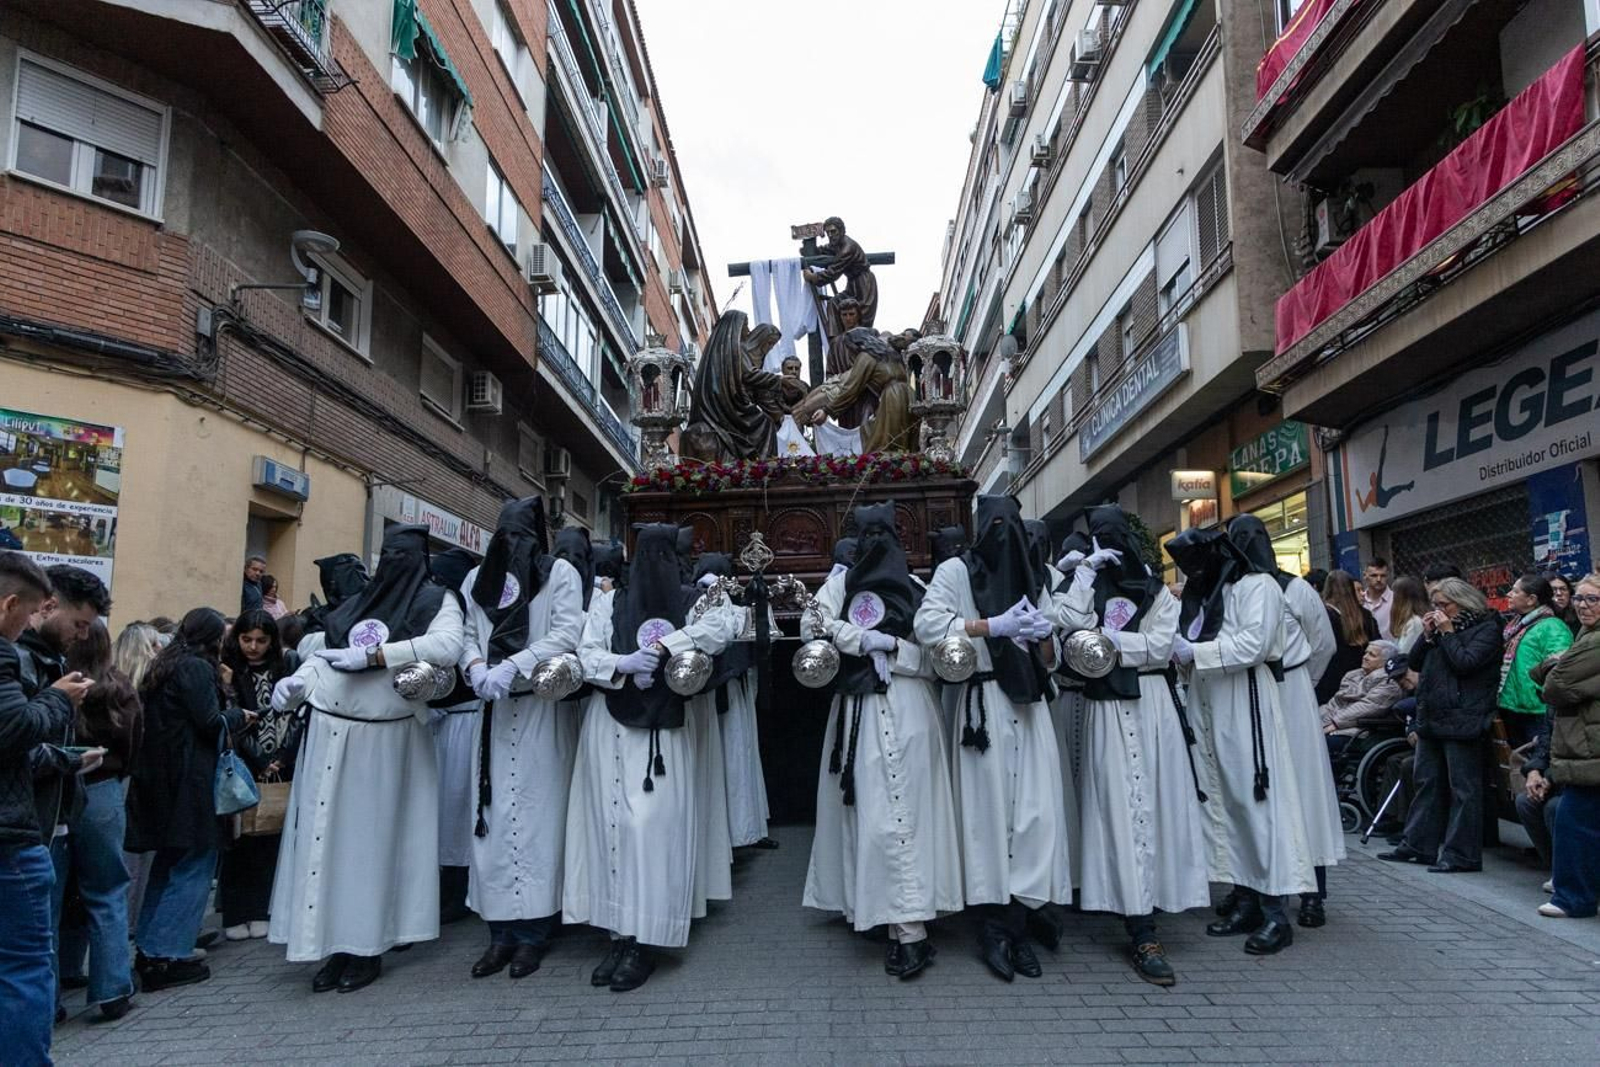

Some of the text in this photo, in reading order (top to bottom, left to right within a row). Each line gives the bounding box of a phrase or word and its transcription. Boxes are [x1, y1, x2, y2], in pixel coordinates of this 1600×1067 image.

[1121, 355, 1160, 406] DENTAL
[1423, 338, 1600, 472] LEGE
[1232, 431, 1277, 470] LANAS
[1246, 442, 1303, 488] PEPA
[1479, 431, 1592, 481] Distribuidor Oficial
[5, 495, 15, 503] de
[19, 496, 33, 505] 30
[35, 499, 53, 509] años
[56, 501, 66, 509] de
[69, 504, 113, 515] experiencia
[1177, 479, 1211, 492] katia
[421, 510, 459, 540] ASTRALUX
[460, 520, 481, 552] ALFA
[68, 557, 104, 566] escolares
